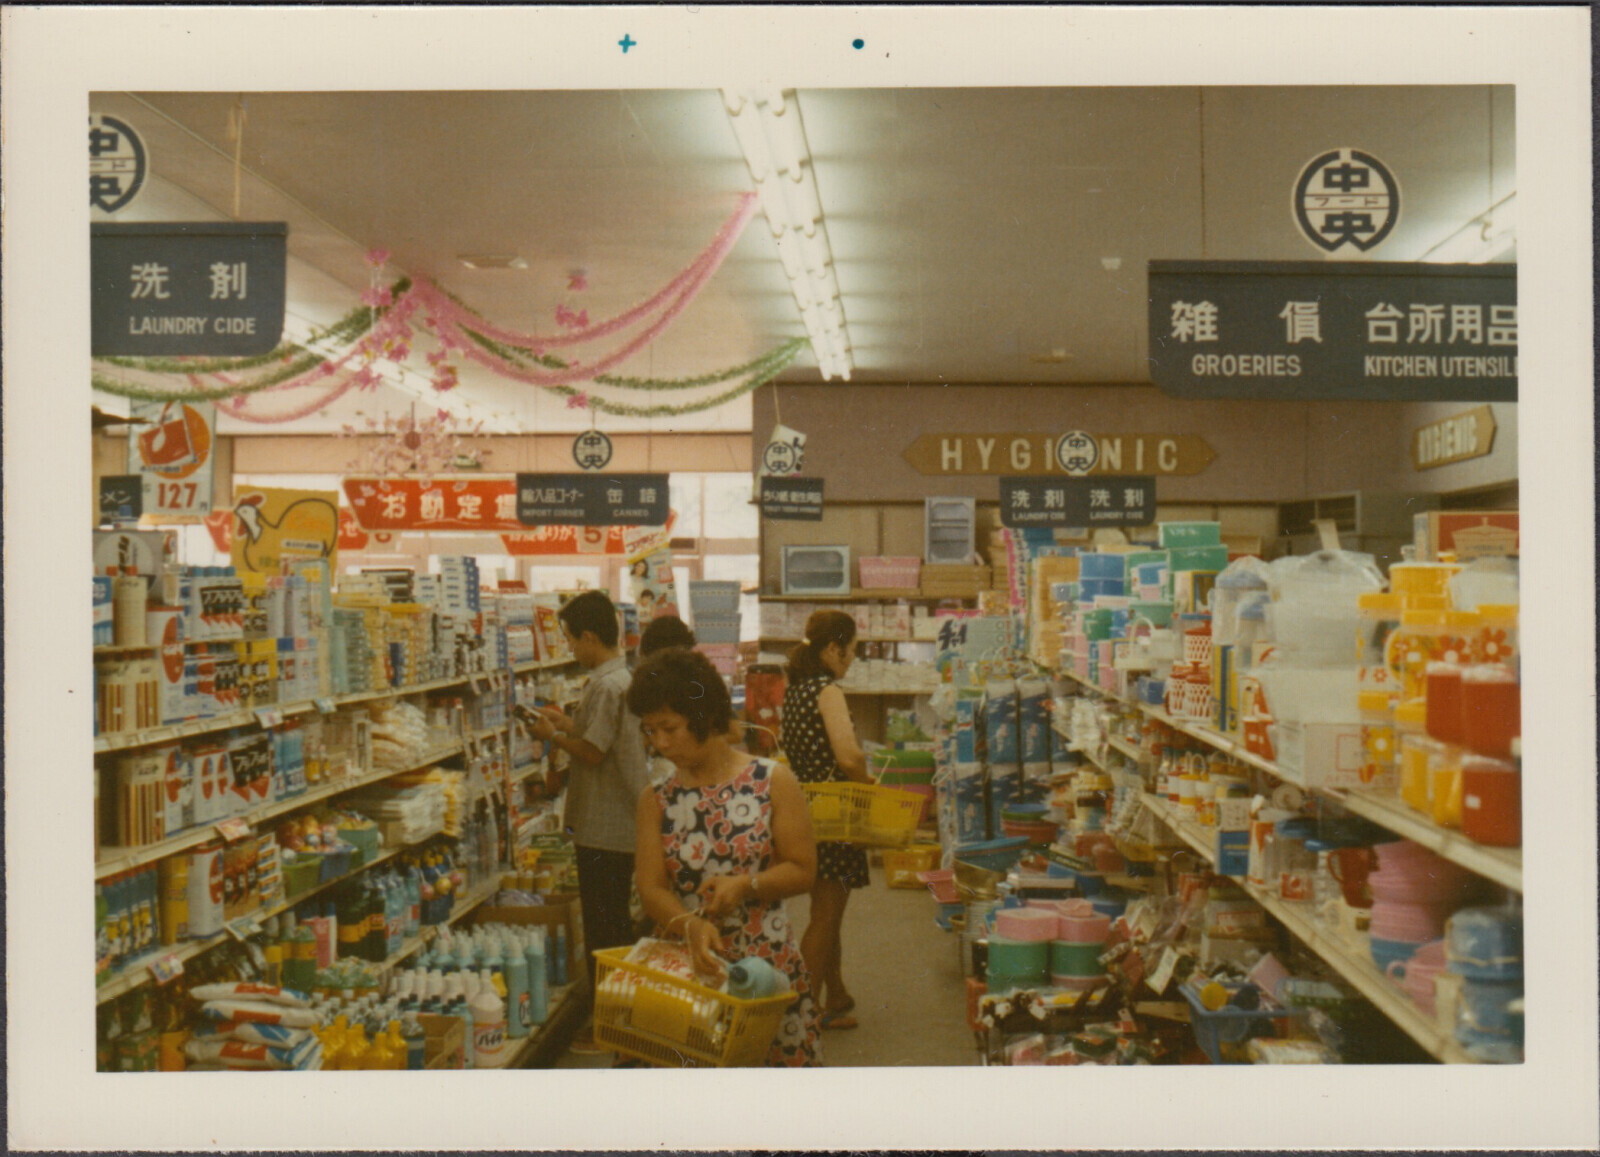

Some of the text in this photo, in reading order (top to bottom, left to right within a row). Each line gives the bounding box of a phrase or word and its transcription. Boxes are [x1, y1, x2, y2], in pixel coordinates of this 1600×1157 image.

[1323, 162, 1369, 192] 中
[1314, 196, 1379, 207] フード
[1320, 211, 1376, 250] 央
[130, 262, 247, 299] 洗剤
[129, 316, 256, 335] LAUNDRY CIDE
[1364, 302, 1517, 346] 台所用品
[1192, 354, 1302, 377] GROERIES
[1364, 355, 1438, 378] KITCHEN
[941, 438, 1178, 471] HYGINIC
[158, 482, 198, 509] 127
[1011, 488, 1144, 508] 洗剤 洗剤
[612, 508, 649, 517] CANNED
